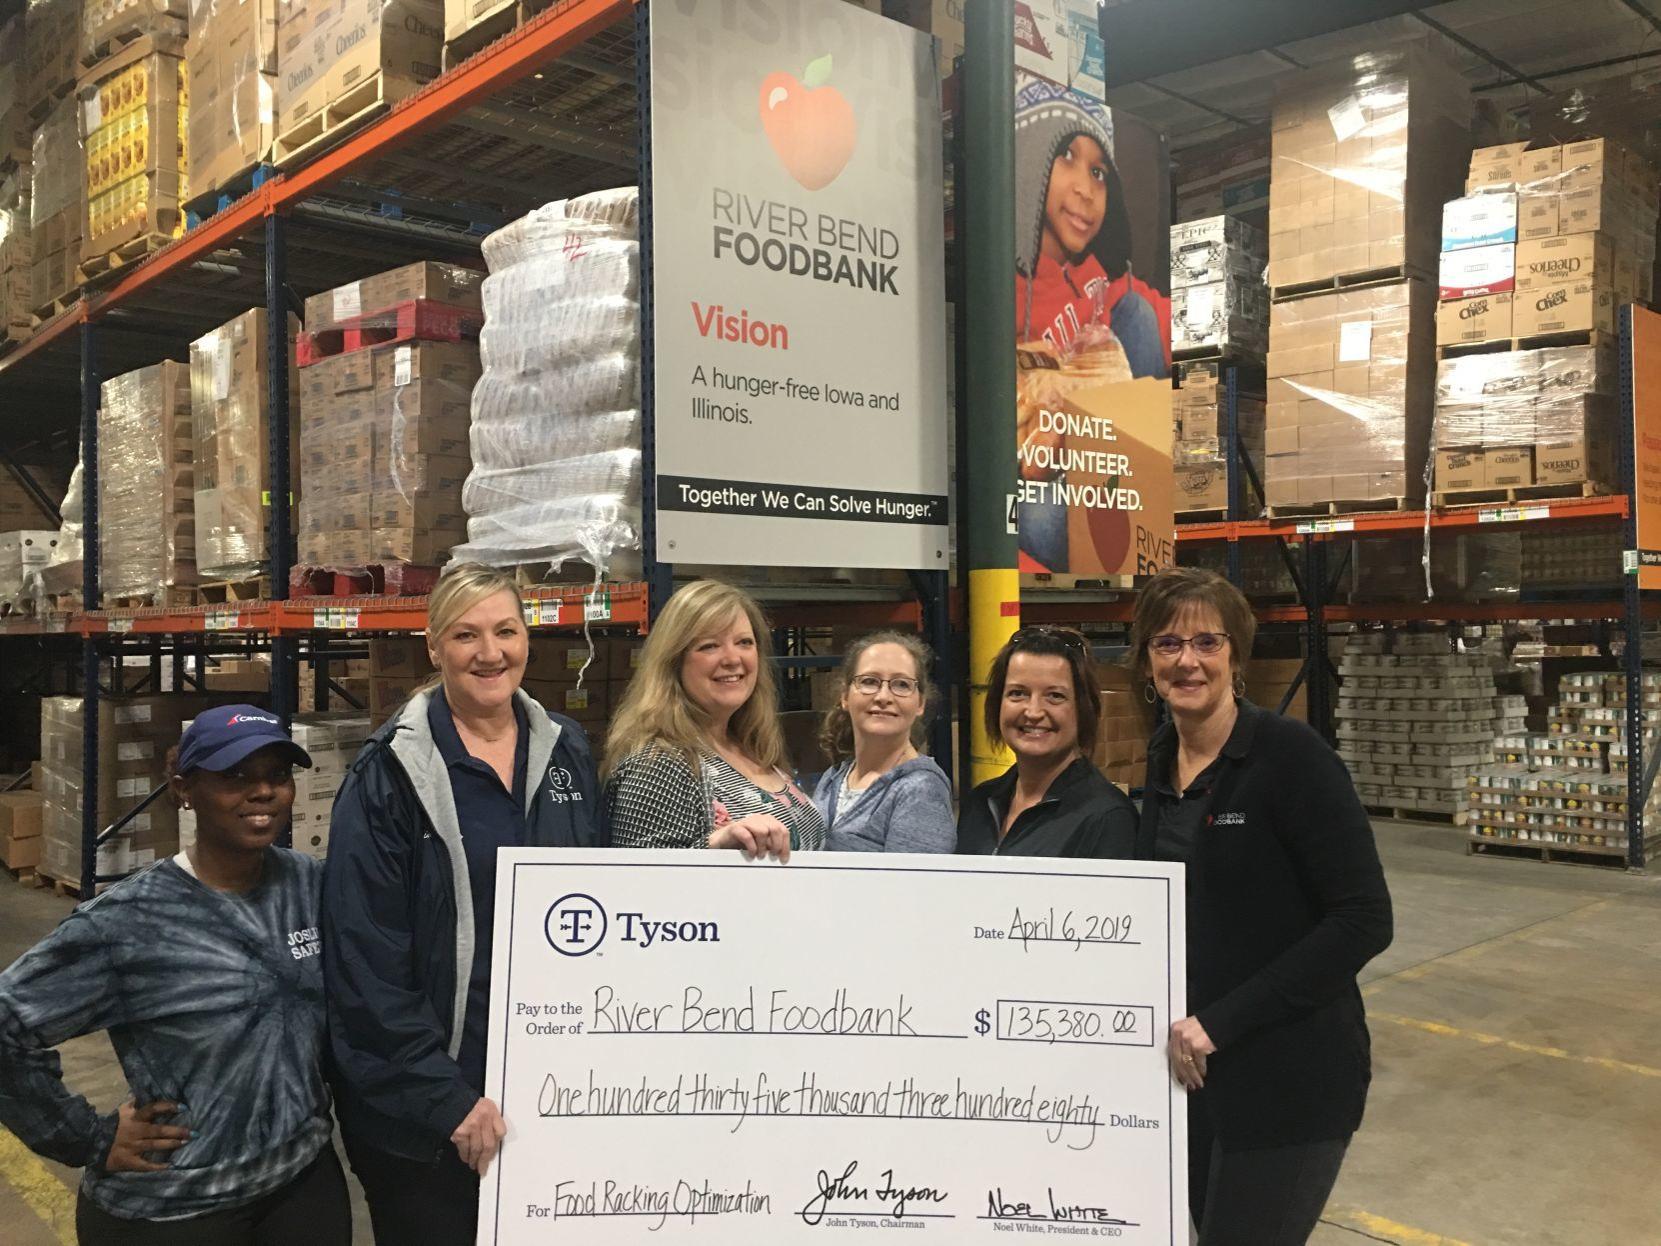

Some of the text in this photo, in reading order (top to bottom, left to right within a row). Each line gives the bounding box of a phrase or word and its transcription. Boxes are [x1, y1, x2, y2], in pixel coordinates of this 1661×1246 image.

[713, 187, 899, 260] RIVER BEND
[713, 225, 900, 295] FOODBANK
[691, 301, 789, 350] Vision
[691, 365, 899, 411] A hunger-free Iowa and
[692, 398, 752, 424] Illinois.
[1039, 409, 1117, 441] DONATE.
[1022, 443, 1134, 477] VOLUNTEER.
[679, 484, 757, 508] Together
[761, 490, 790, 508] We
[794, 493, 825, 511] Can
[829, 495, 871, 514] Solve
[875, 498, 932, 519] Hunger.
[1052, 482, 1143, 511] INVOLVED.
[1136, 524, 1177, 565] RIVE
[549, 789, 583, 804] Tysn
[616, 912, 720, 948] Tyson
[974, 926, 1005, 940] Date
[1008, 907, 1053, 952] April
[516, 1002, 583, 1018] Pay to the
[594, 985, 918, 1036] River Bend Foodbank
[974, 1007, 991, 1037] $
[526, 1020, 585, 1035] Order of
[538, 1069, 1100, 1150] One hundred thirty five thousand three hundred eighty
[1110, 1114, 1160, 1129] Dollars
[554, 1178, 771, 1231] Food Racking Optimization
[802, 1160, 949, 1225] John Tyson
[526, 1204, 550, 1218] For
[826, 1218, 926, 1230] John Tyson, Chairman
[993, 1222, 1122, 1237] Noel White, President & CEO
